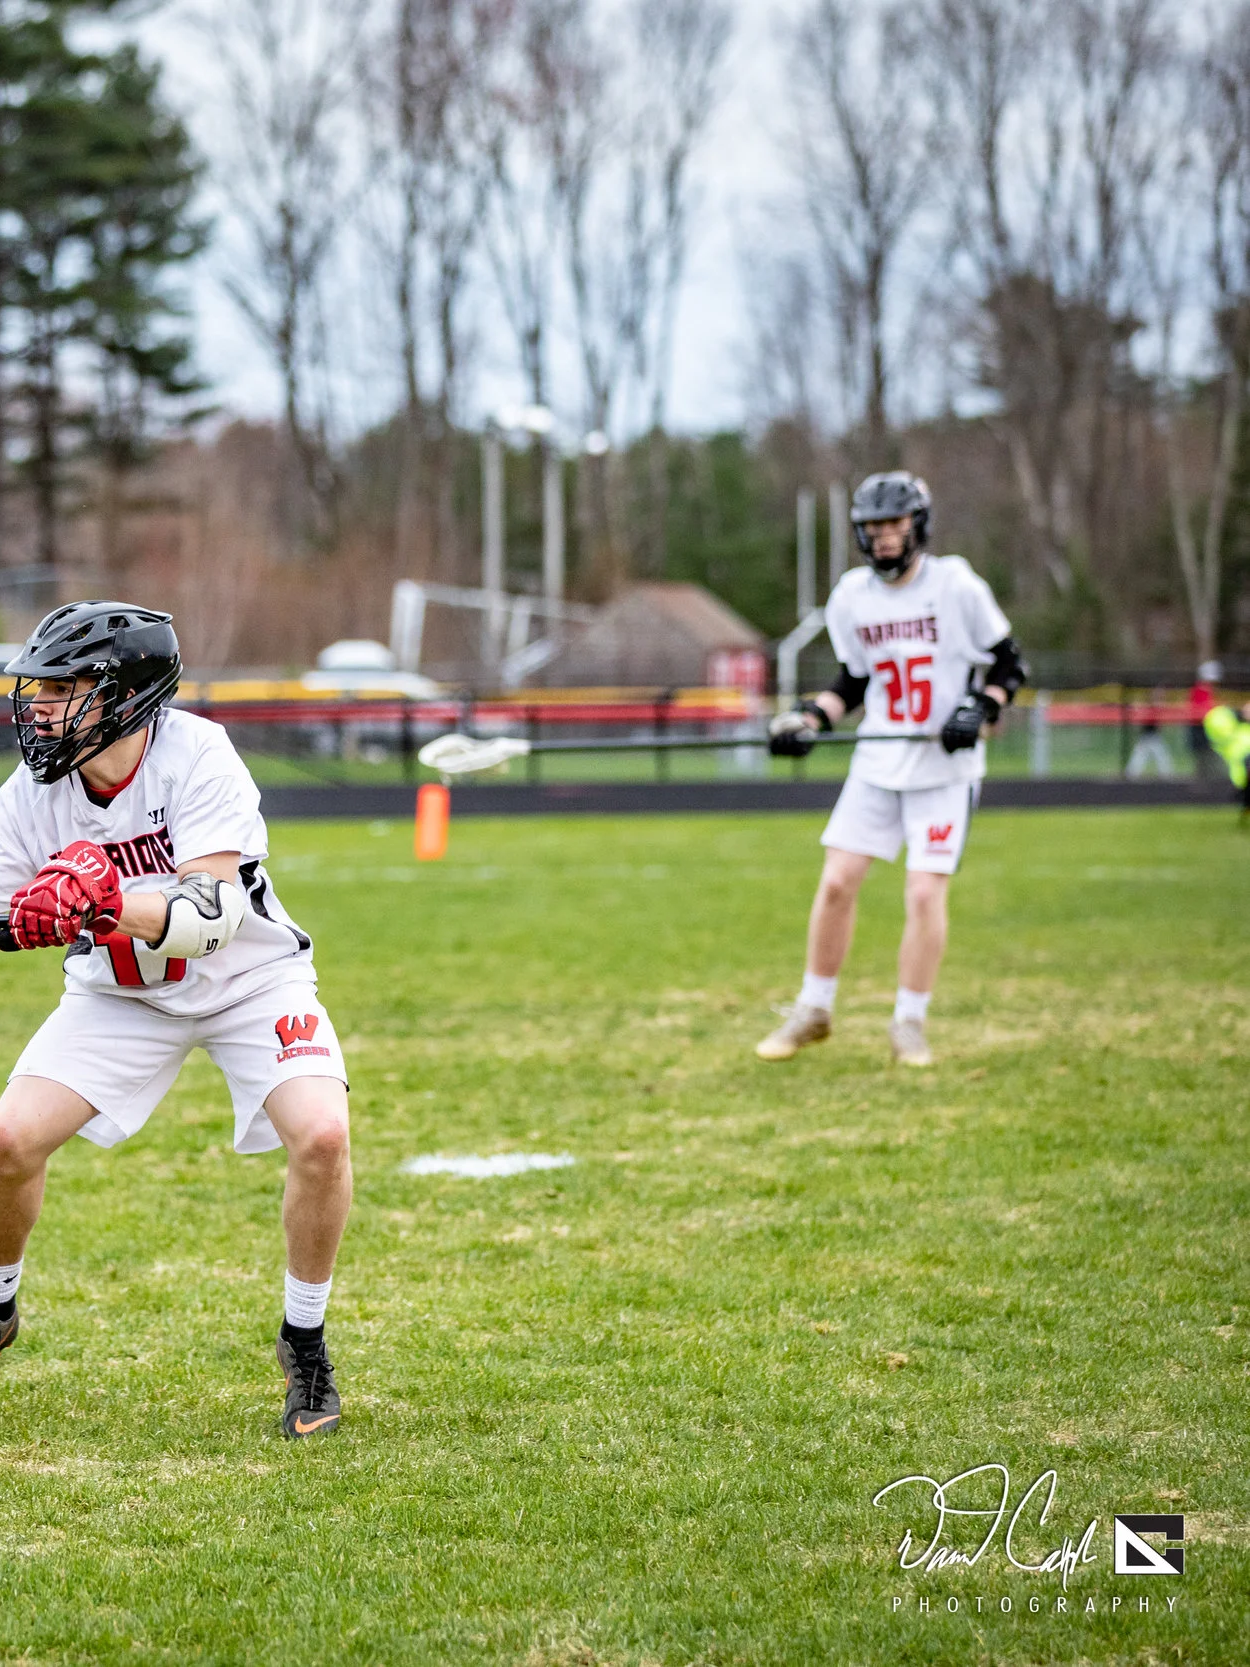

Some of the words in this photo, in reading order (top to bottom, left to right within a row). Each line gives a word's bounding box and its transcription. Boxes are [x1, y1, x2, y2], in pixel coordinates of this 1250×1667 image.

[92, 662, 107, 671] R
[874, 655, 934, 723] 26
[275, 1013, 319, 1048] W
